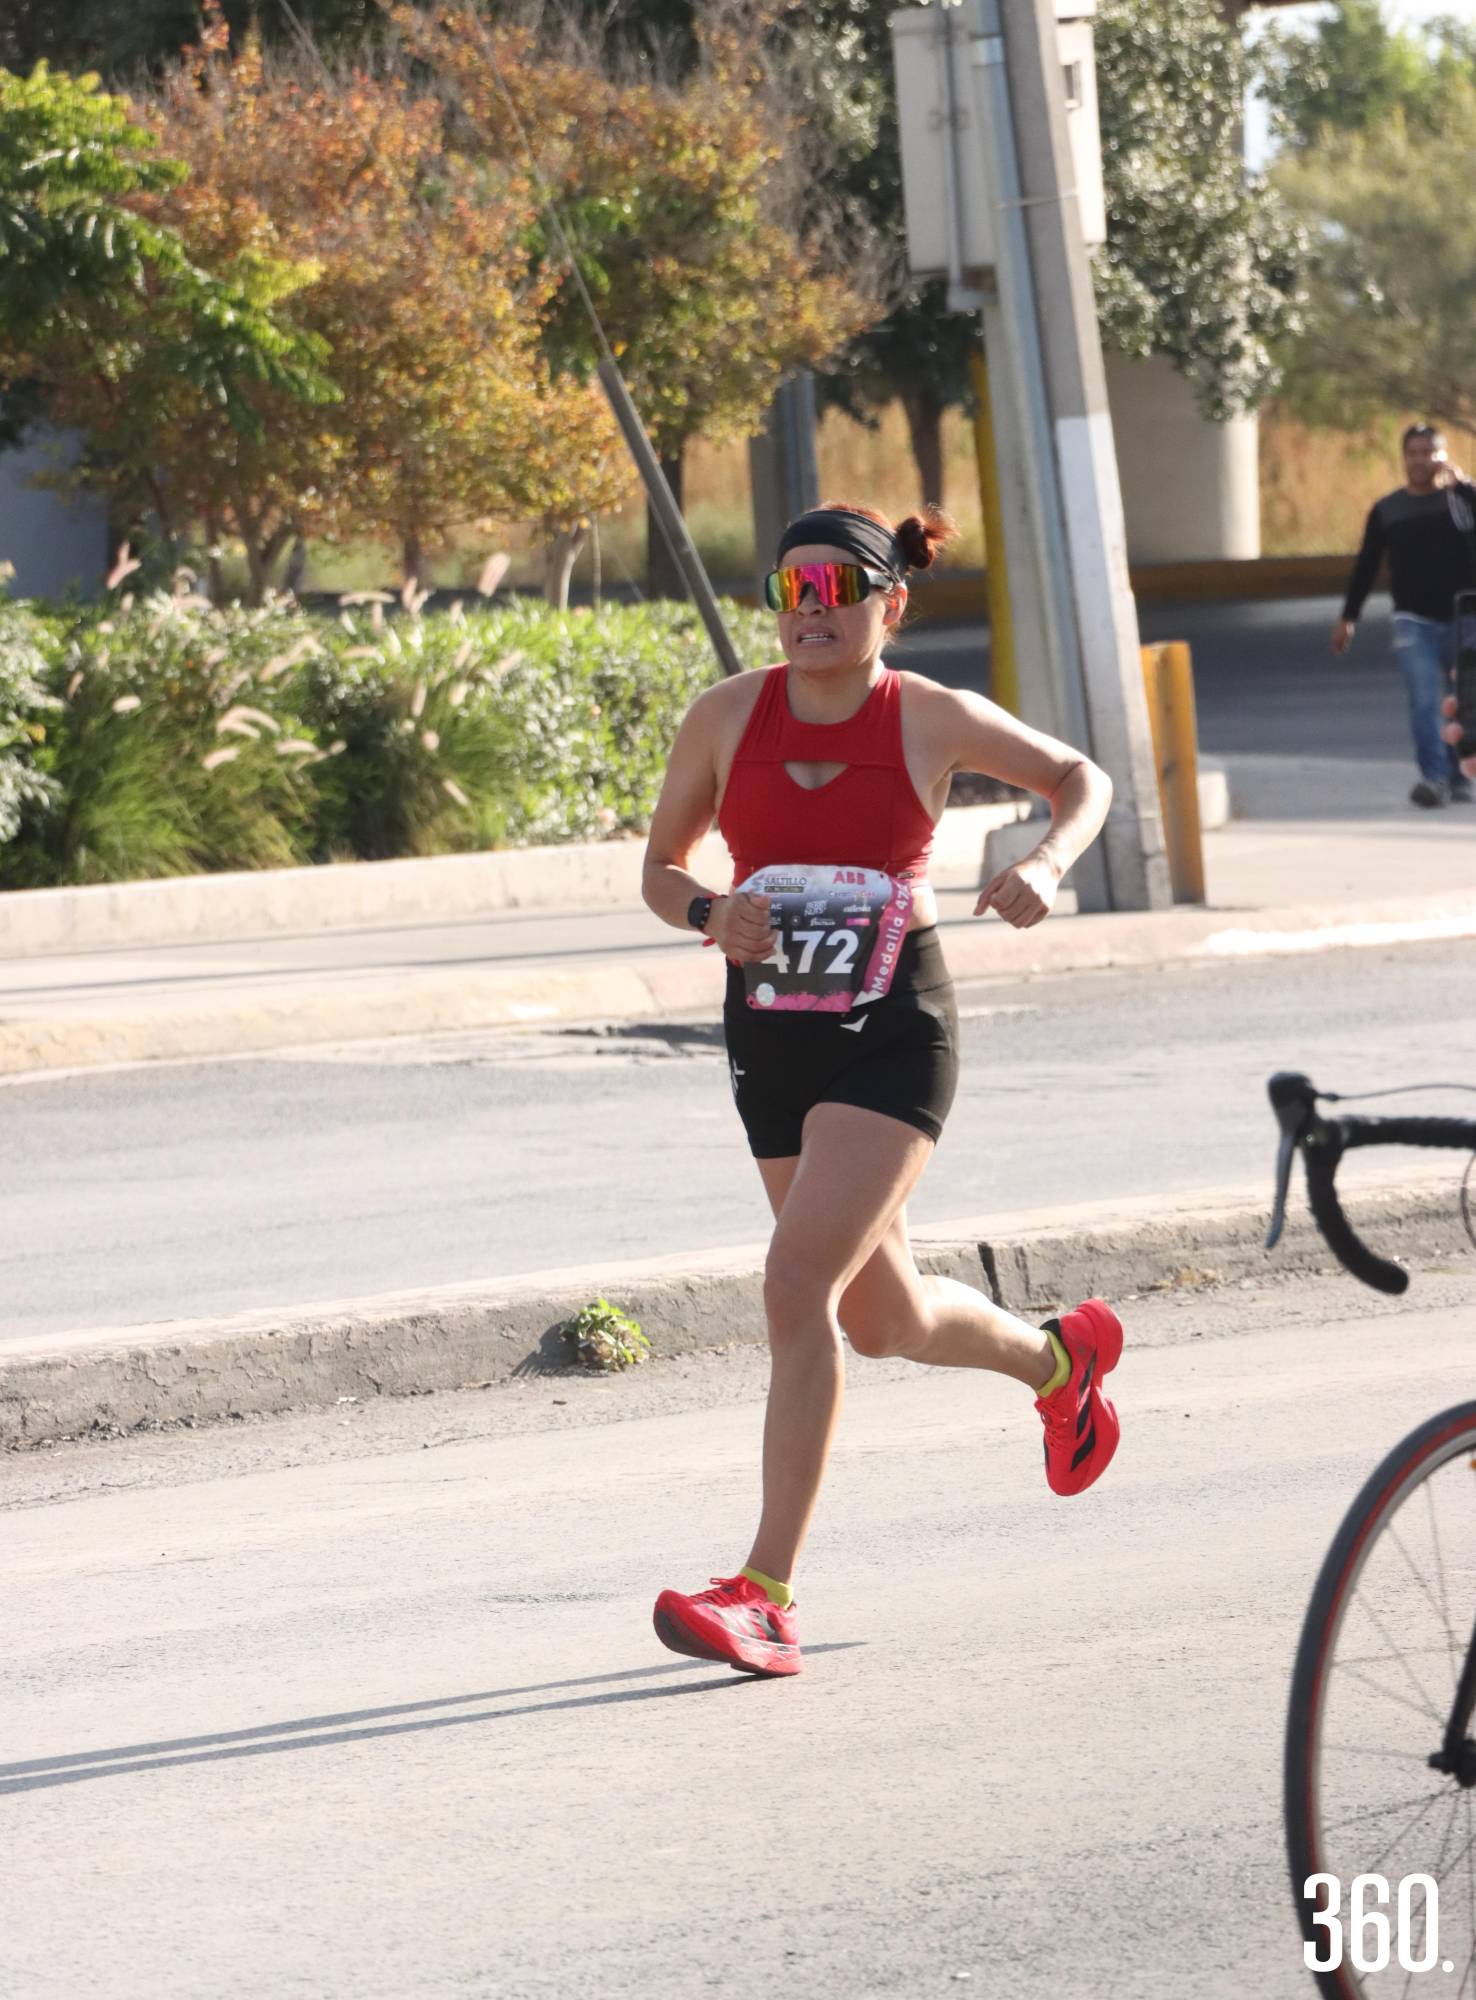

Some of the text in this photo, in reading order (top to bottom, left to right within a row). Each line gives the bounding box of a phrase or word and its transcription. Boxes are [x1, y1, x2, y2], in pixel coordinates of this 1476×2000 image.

[764, 877, 808, 885] SALTILLO
[833, 871, 866, 885] ABB
[761, 929, 859, 974] 472
[871, 917, 905, 991] Medalla
